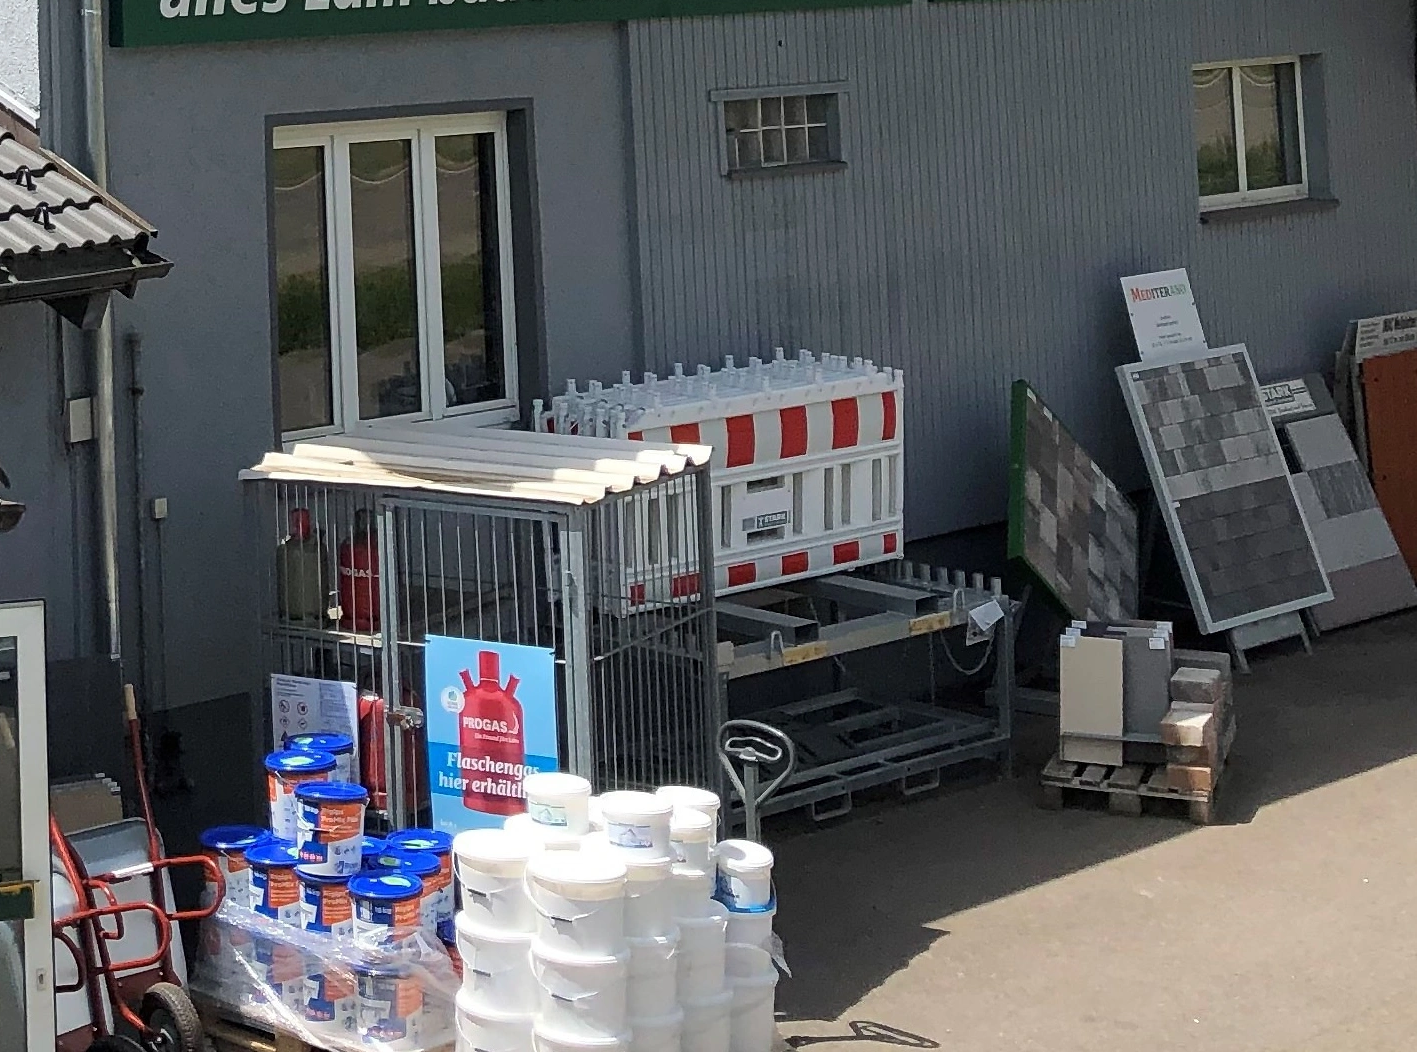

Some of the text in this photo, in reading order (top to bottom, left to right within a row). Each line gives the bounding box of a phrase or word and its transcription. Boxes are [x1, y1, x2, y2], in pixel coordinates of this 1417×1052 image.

[463, 716, 508, 734] PROGAS
[438, 771, 527, 799] hier erhältl
